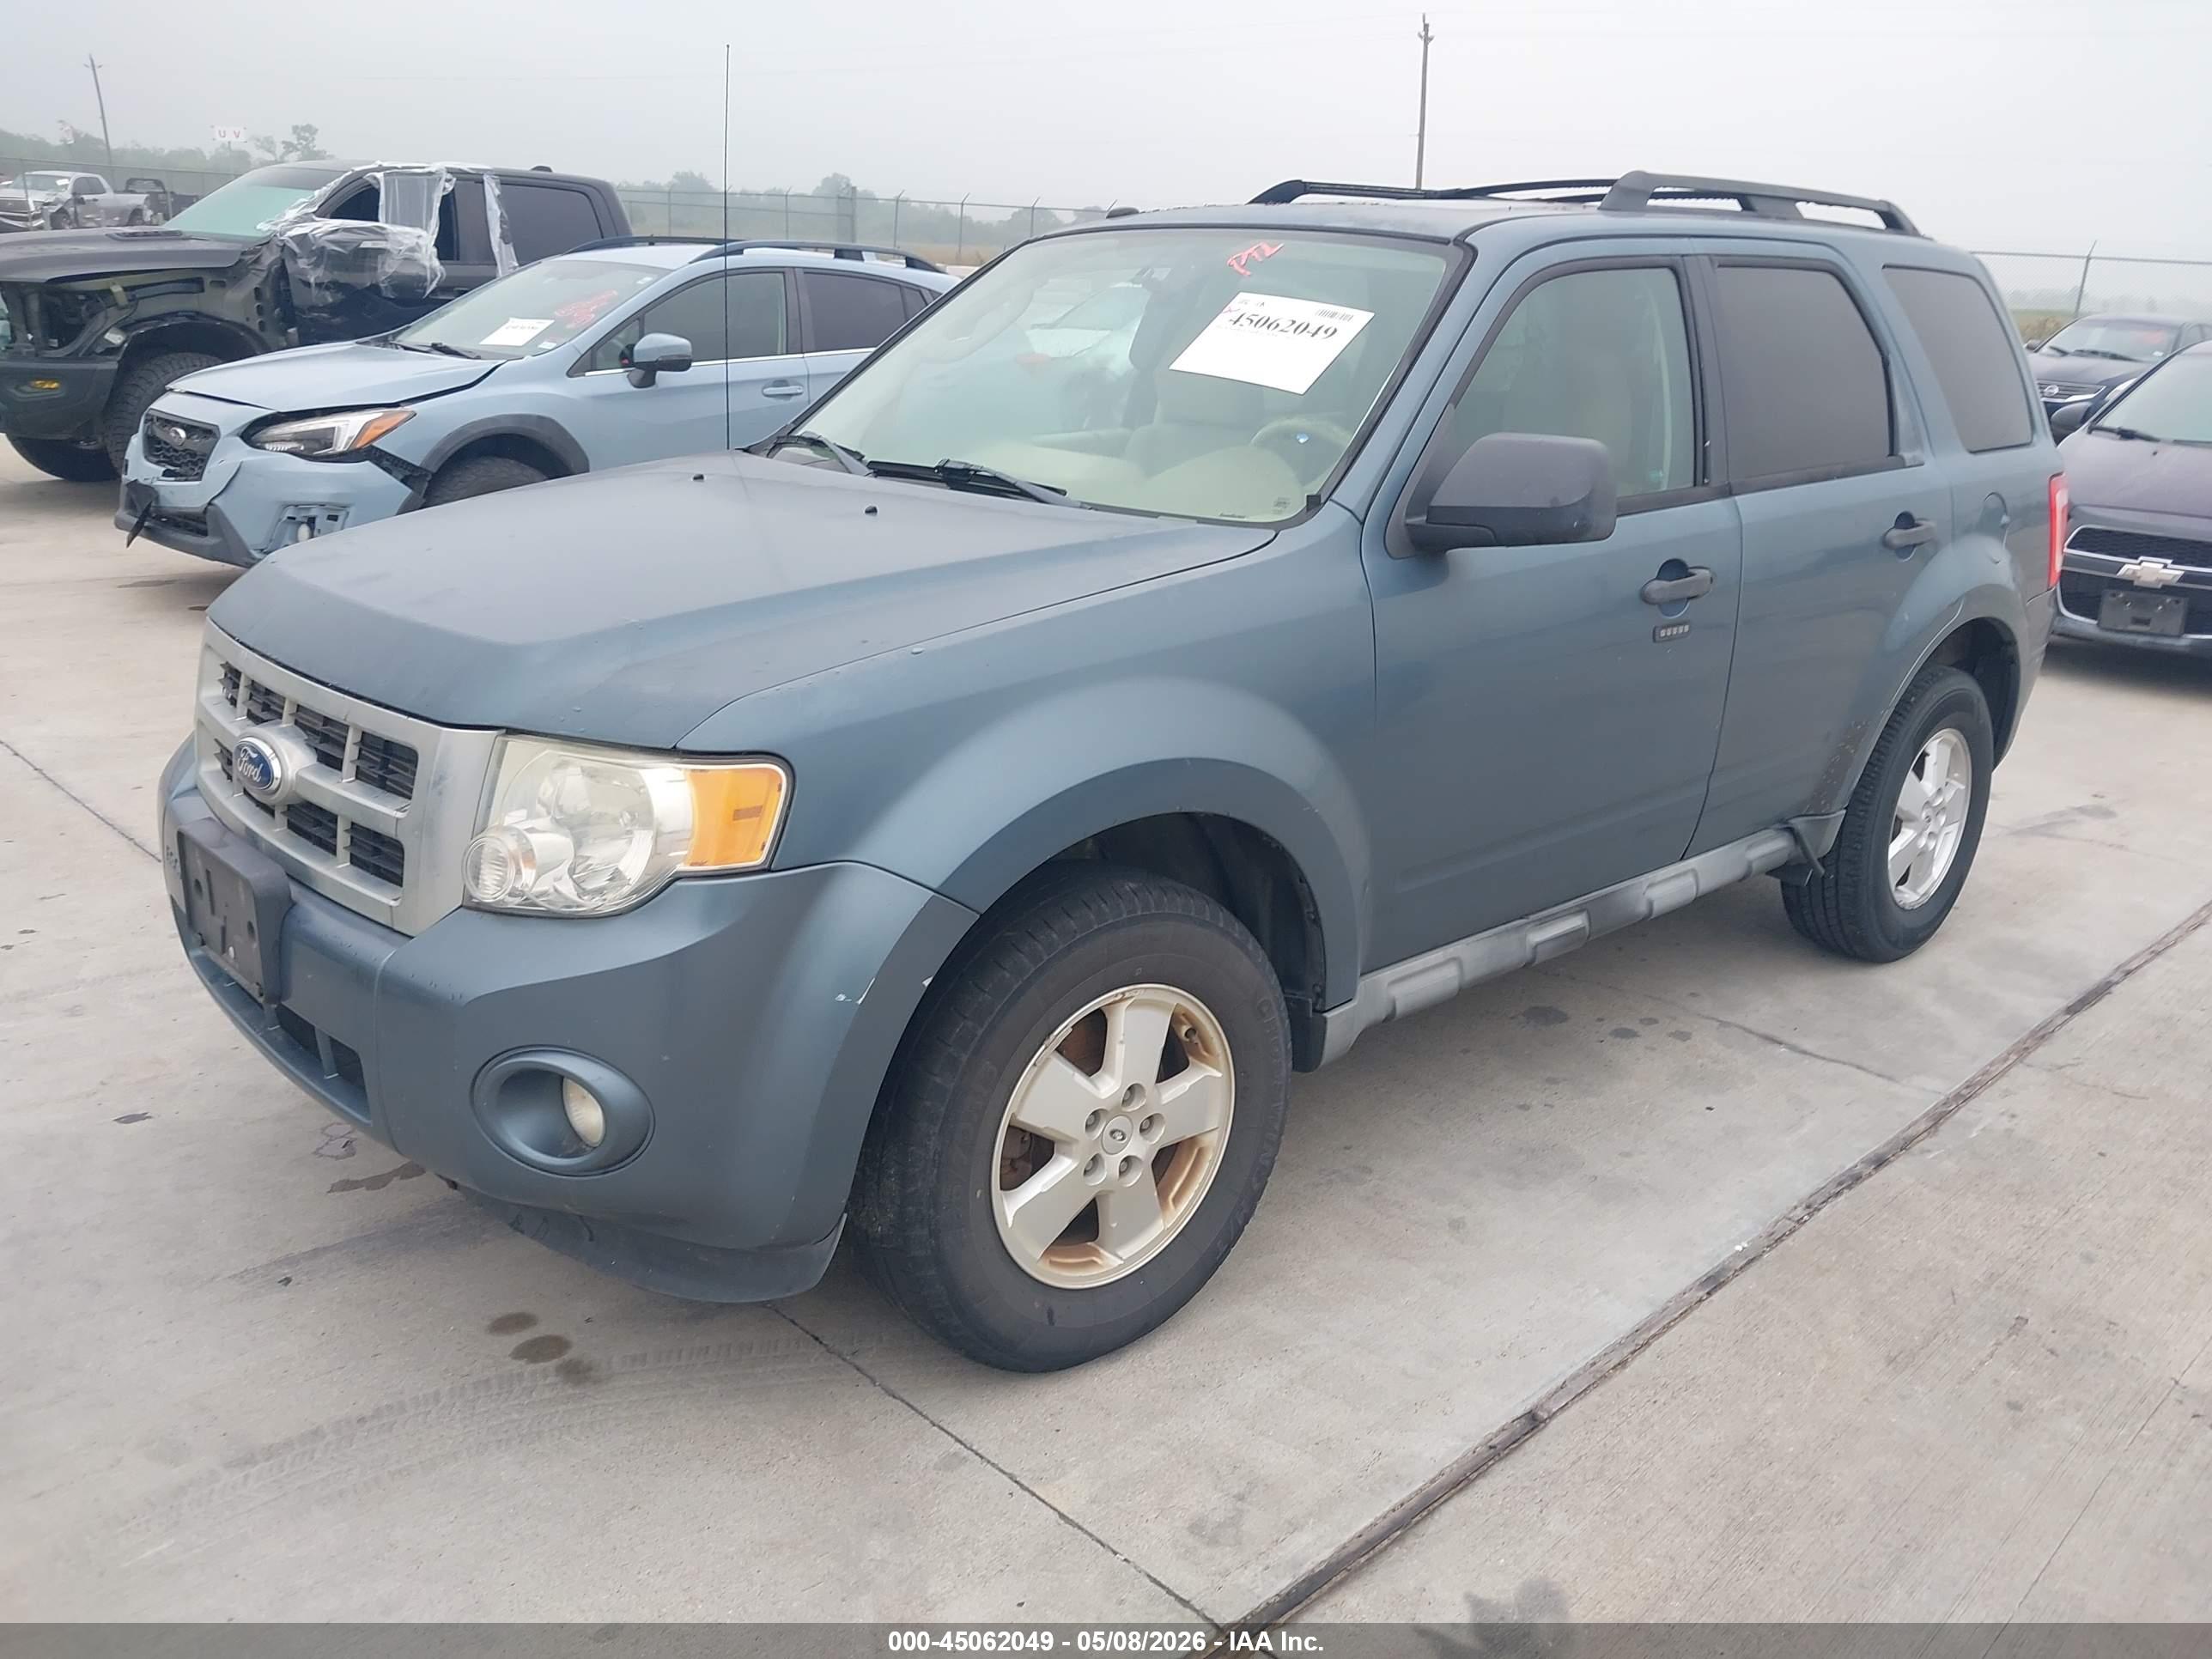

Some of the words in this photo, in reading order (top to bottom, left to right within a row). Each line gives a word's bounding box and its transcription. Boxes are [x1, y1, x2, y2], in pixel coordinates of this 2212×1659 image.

[218, 130, 227, 138] U
[233, 130, 240, 139] V
[1229, 312, 1338, 339] 45062049
[238, 746, 263, 782] Ford
